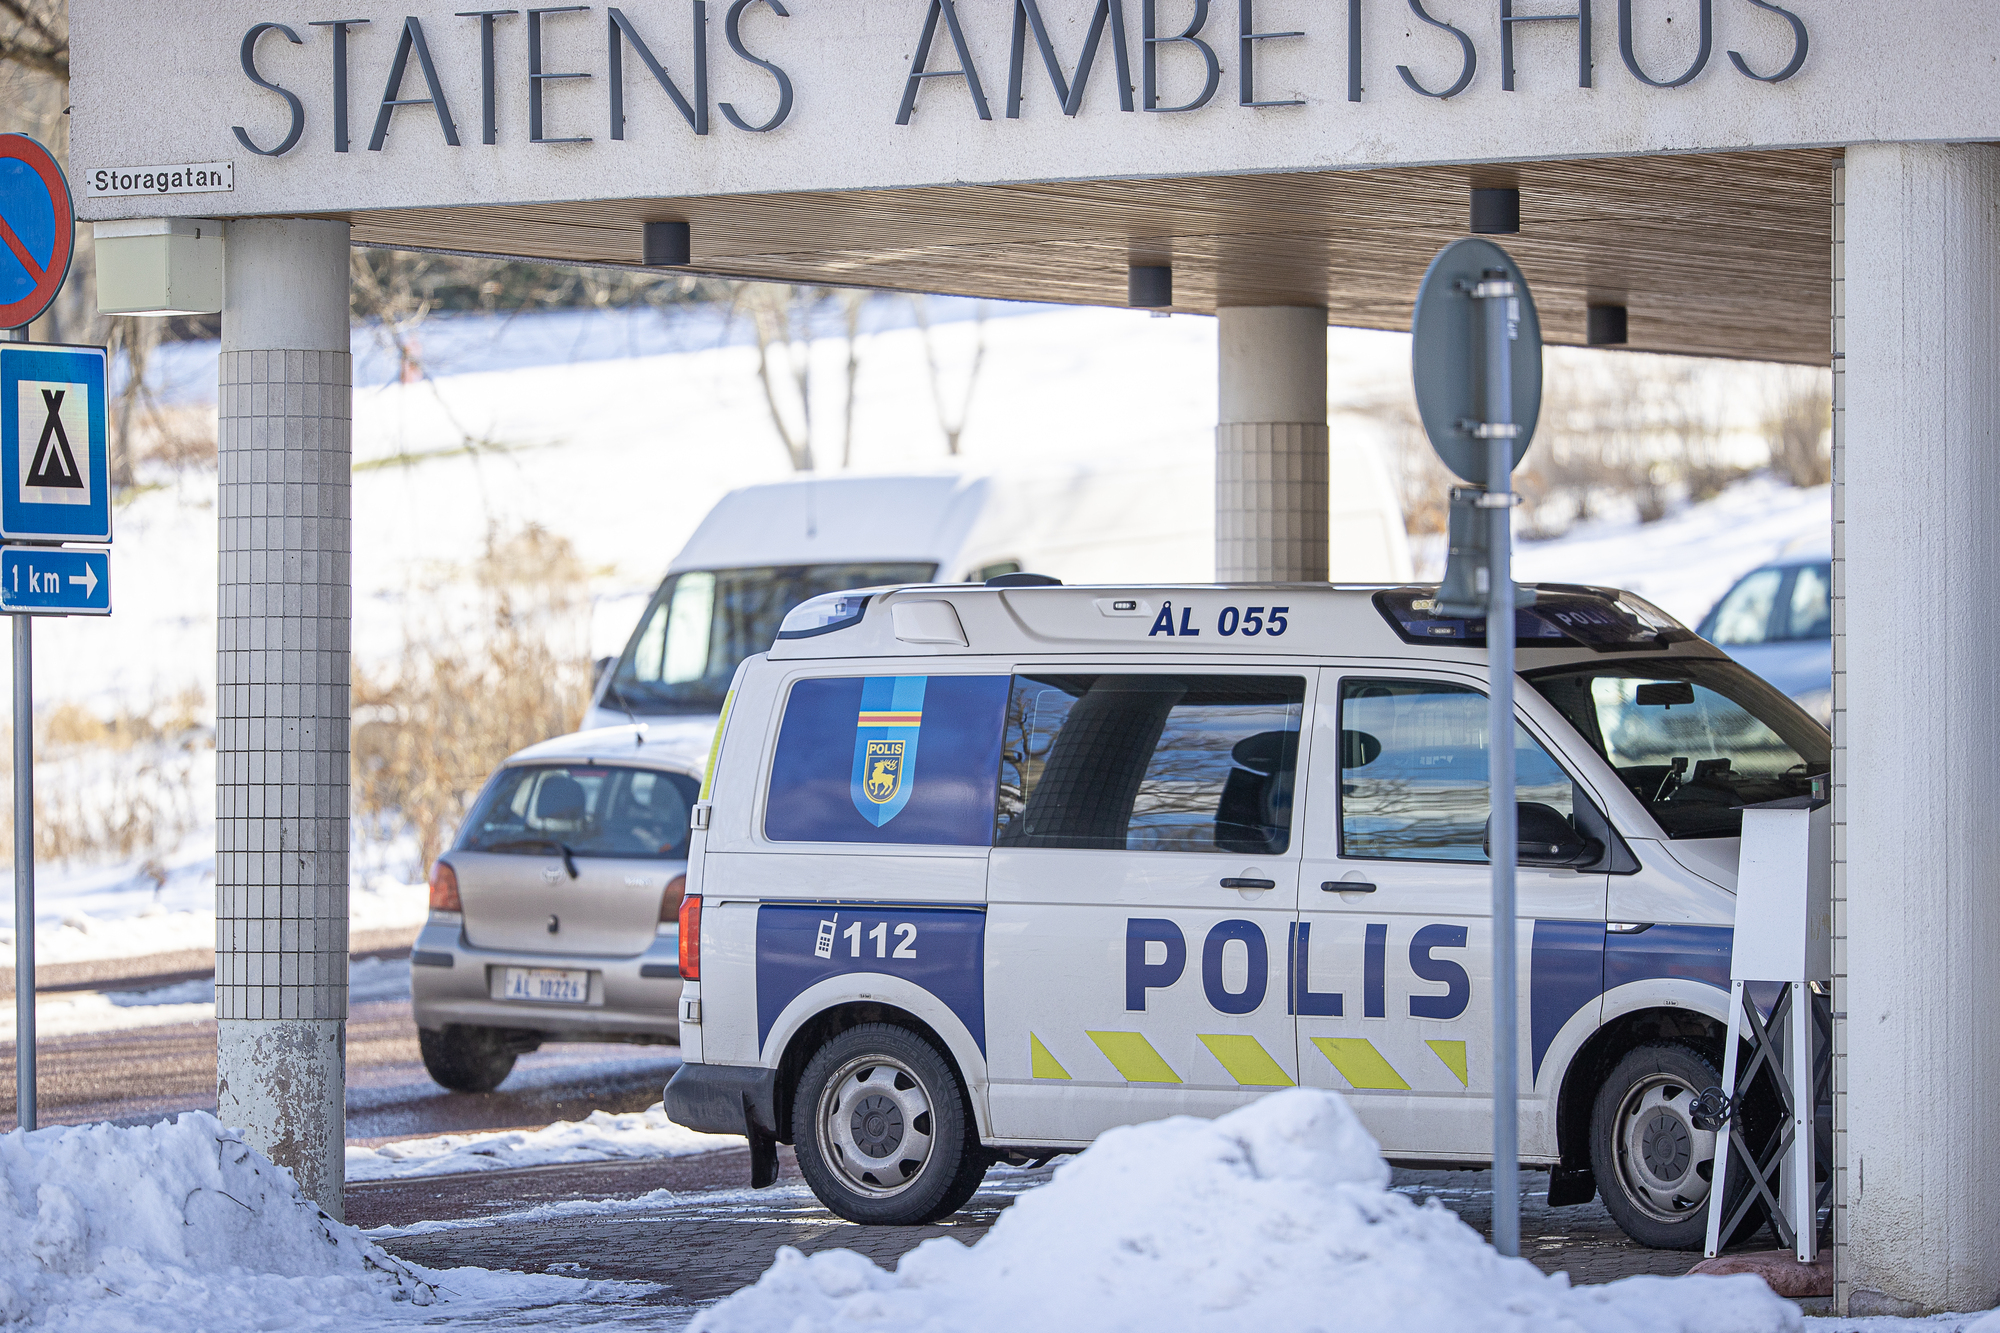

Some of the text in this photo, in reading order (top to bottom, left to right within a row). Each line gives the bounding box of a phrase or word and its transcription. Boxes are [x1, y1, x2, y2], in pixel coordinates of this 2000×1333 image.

[232, 0, 794, 156] STATENS
[95, 168, 222, 192] Storagatan
[12, 564, 60, 593] 1 km
[1148, 600, 1290, 637] ÅL 055
[1555, 611, 1616, 628] POLI
[869, 743, 902, 755] POLIS
[843, 921, 917, 959] 112
[1125, 918, 1471, 1020] POLIS
